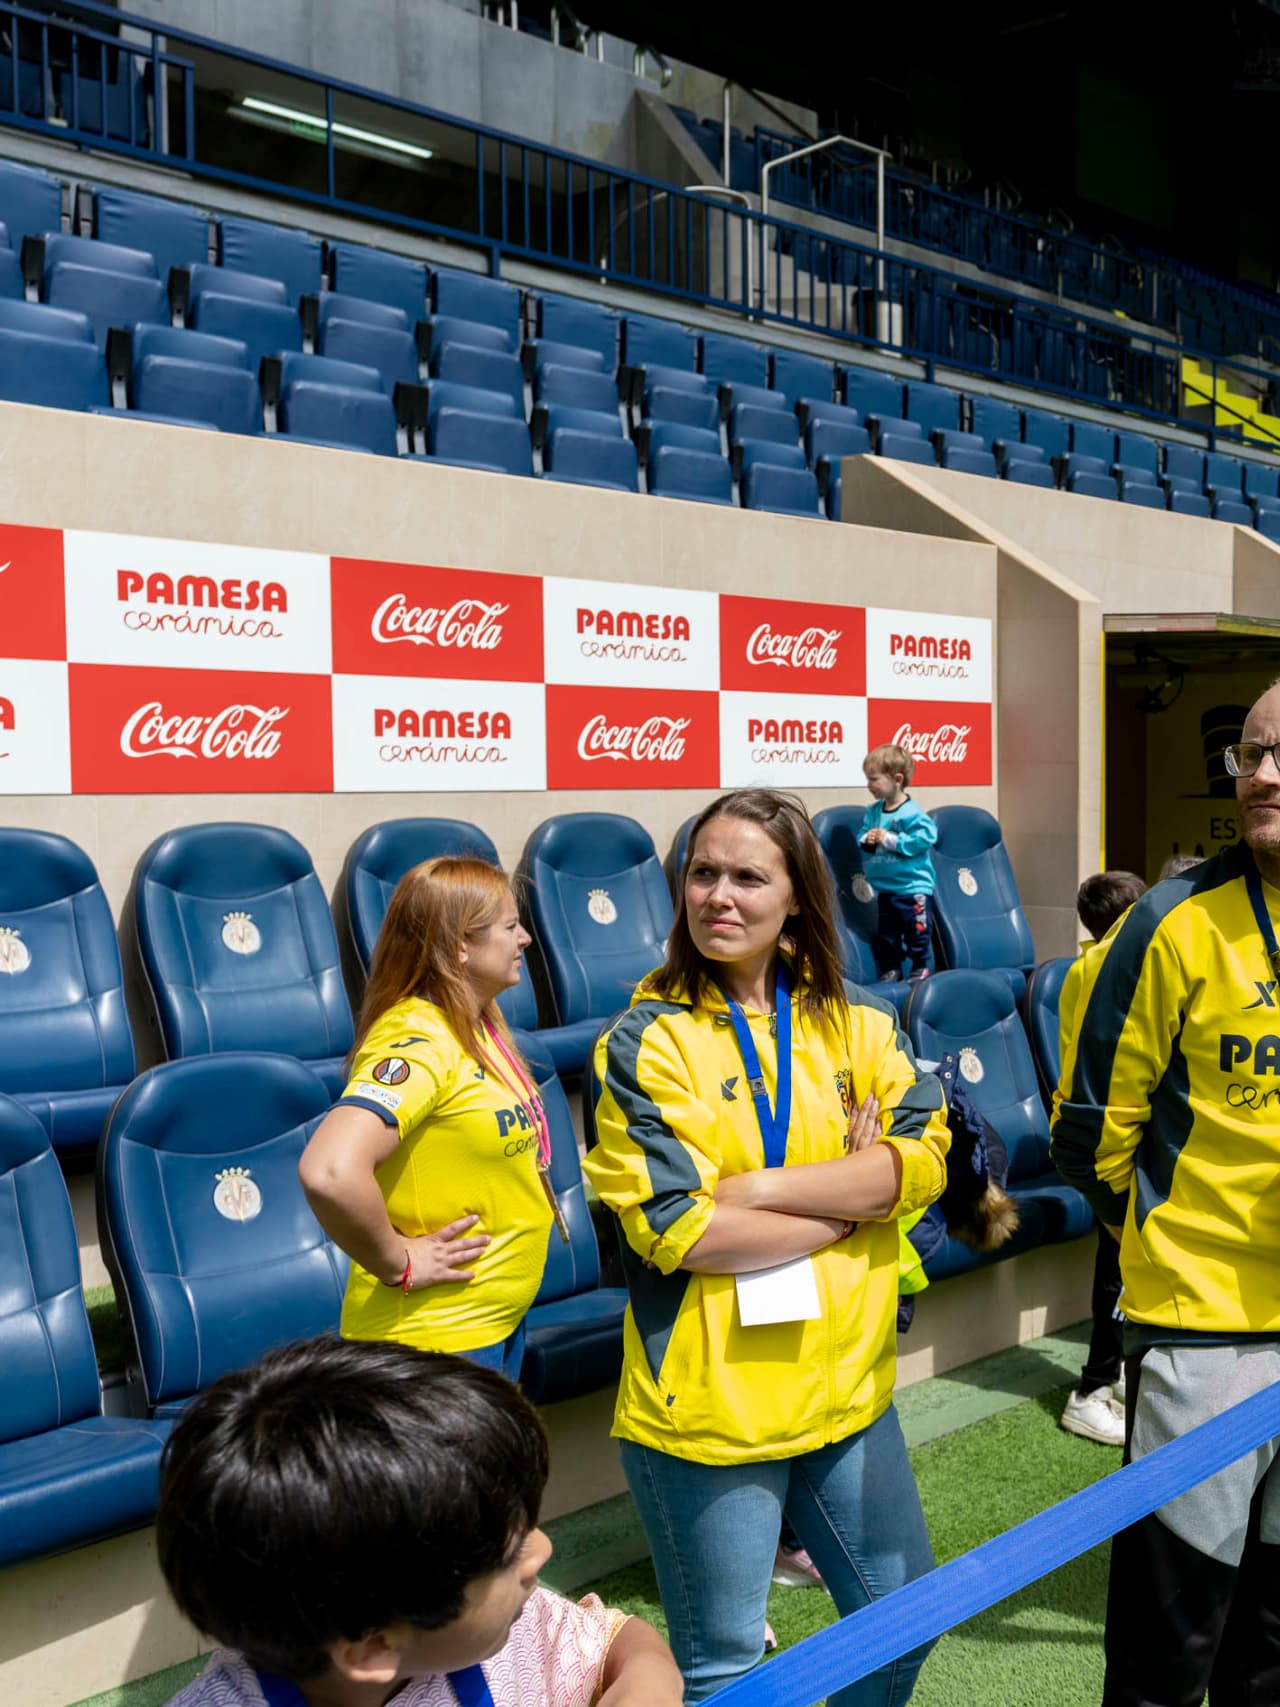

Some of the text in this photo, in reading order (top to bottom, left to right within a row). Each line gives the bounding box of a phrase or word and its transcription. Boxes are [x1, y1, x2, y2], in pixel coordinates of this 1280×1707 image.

[117, 570, 288, 613] PAMESA
[124, 608, 284, 638] cerámica
[371, 593, 510, 650] Coca-Cola
[577, 607, 690, 642] PAMESA
[580, 639, 688, 662] cerámica
[746, 623, 843, 670] Coca-Cola
[890, 633, 972, 661] PAMESA
[893, 658, 969, 679] cerámica
[120, 701, 290, 759] Coca-Cola
[374, 708, 512, 740] PAMESA
[577, 714, 692, 761] Coca-Cola
[748, 719, 843, 744] PAMESA
[379, 742, 508, 763] cerámica
[751, 746, 840, 764] cerámica
[892, 723, 972, 763] Coca-Cola
